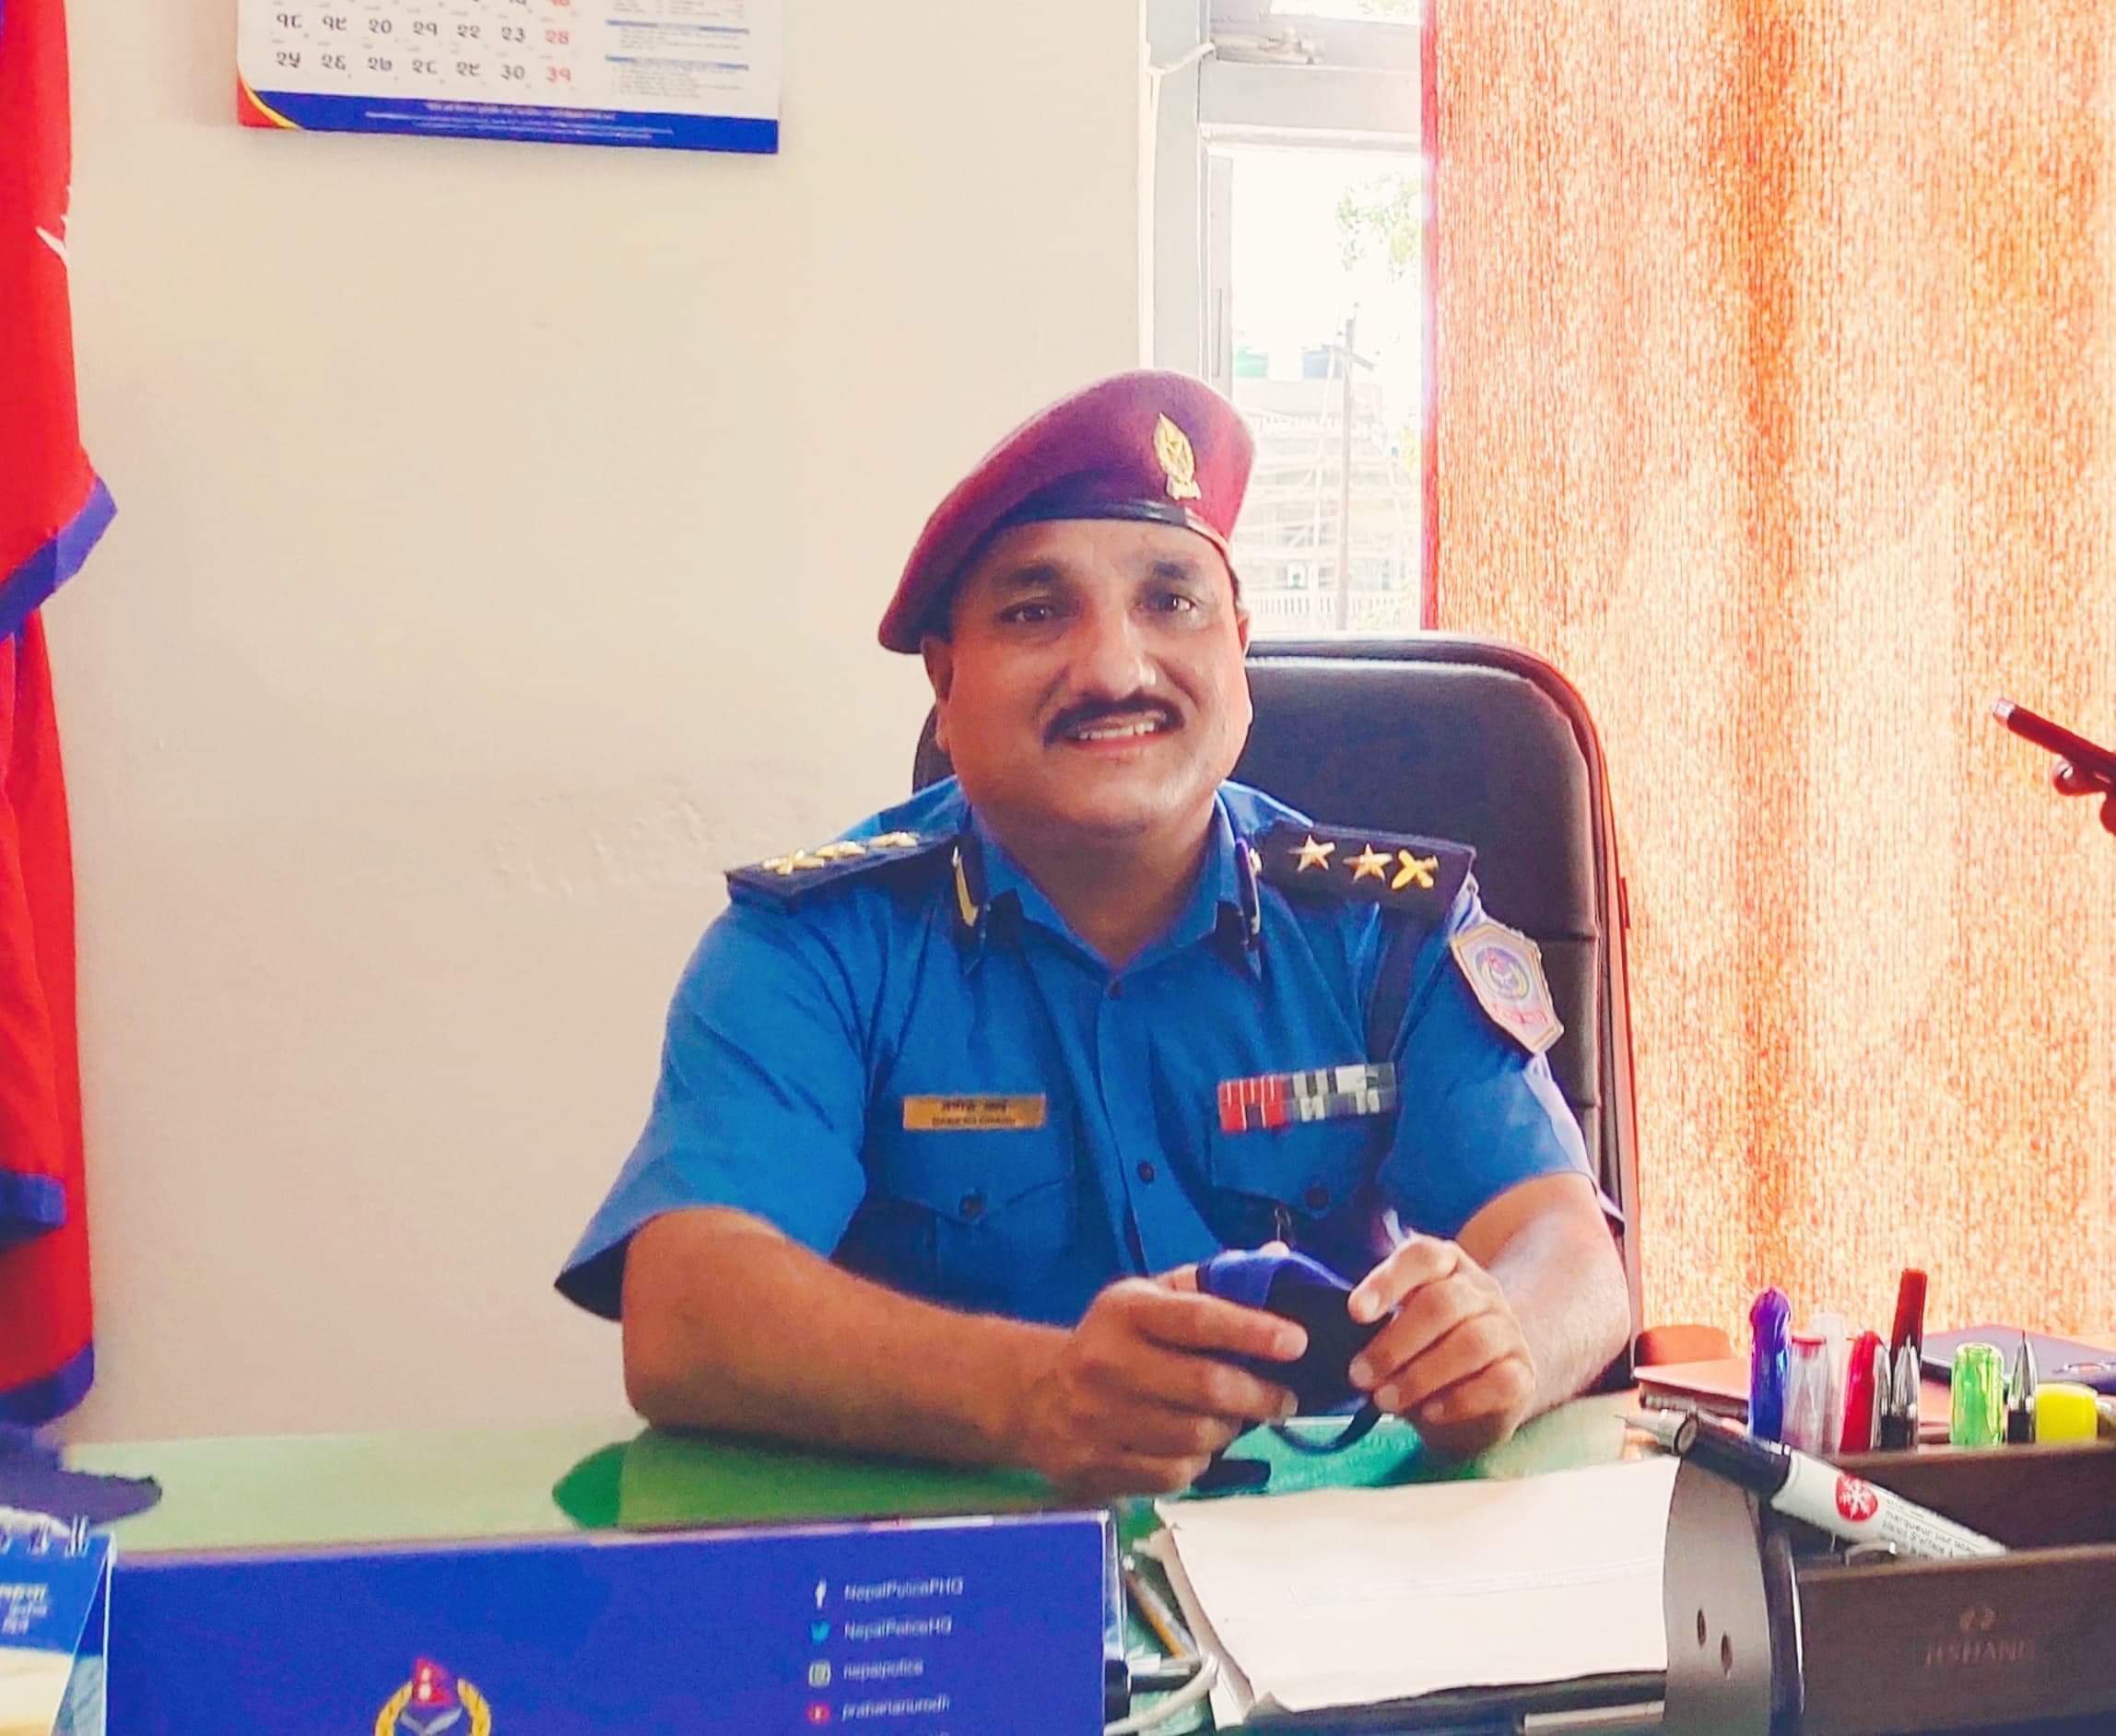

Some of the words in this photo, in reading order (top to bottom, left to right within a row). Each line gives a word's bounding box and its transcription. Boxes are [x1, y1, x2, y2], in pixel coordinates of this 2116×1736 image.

[276, 13, 302, 29] १८
[322, 16, 347, 31] १९
[368, 18, 393, 34] २०
[413, 21, 438, 37] २१
[456, 24, 480, 40] २२
[500, 26, 525, 43] २३
[546, 30, 569, 45] २४
[276, 51, 301, 69] २५
[321, 53, 347, 71] २६
[368, 56, 393, 71] २७
[412, 59, 437, 75] २८
[456, 61, 480, 76] २९
[500, 65, 525, 81] ३०
[547, 67, 571, 83] ३१
[844, 1578, 963, 1601] NepalPolicePHQ
[844, 1617, 952, 1641] NepalPoliceHQ
